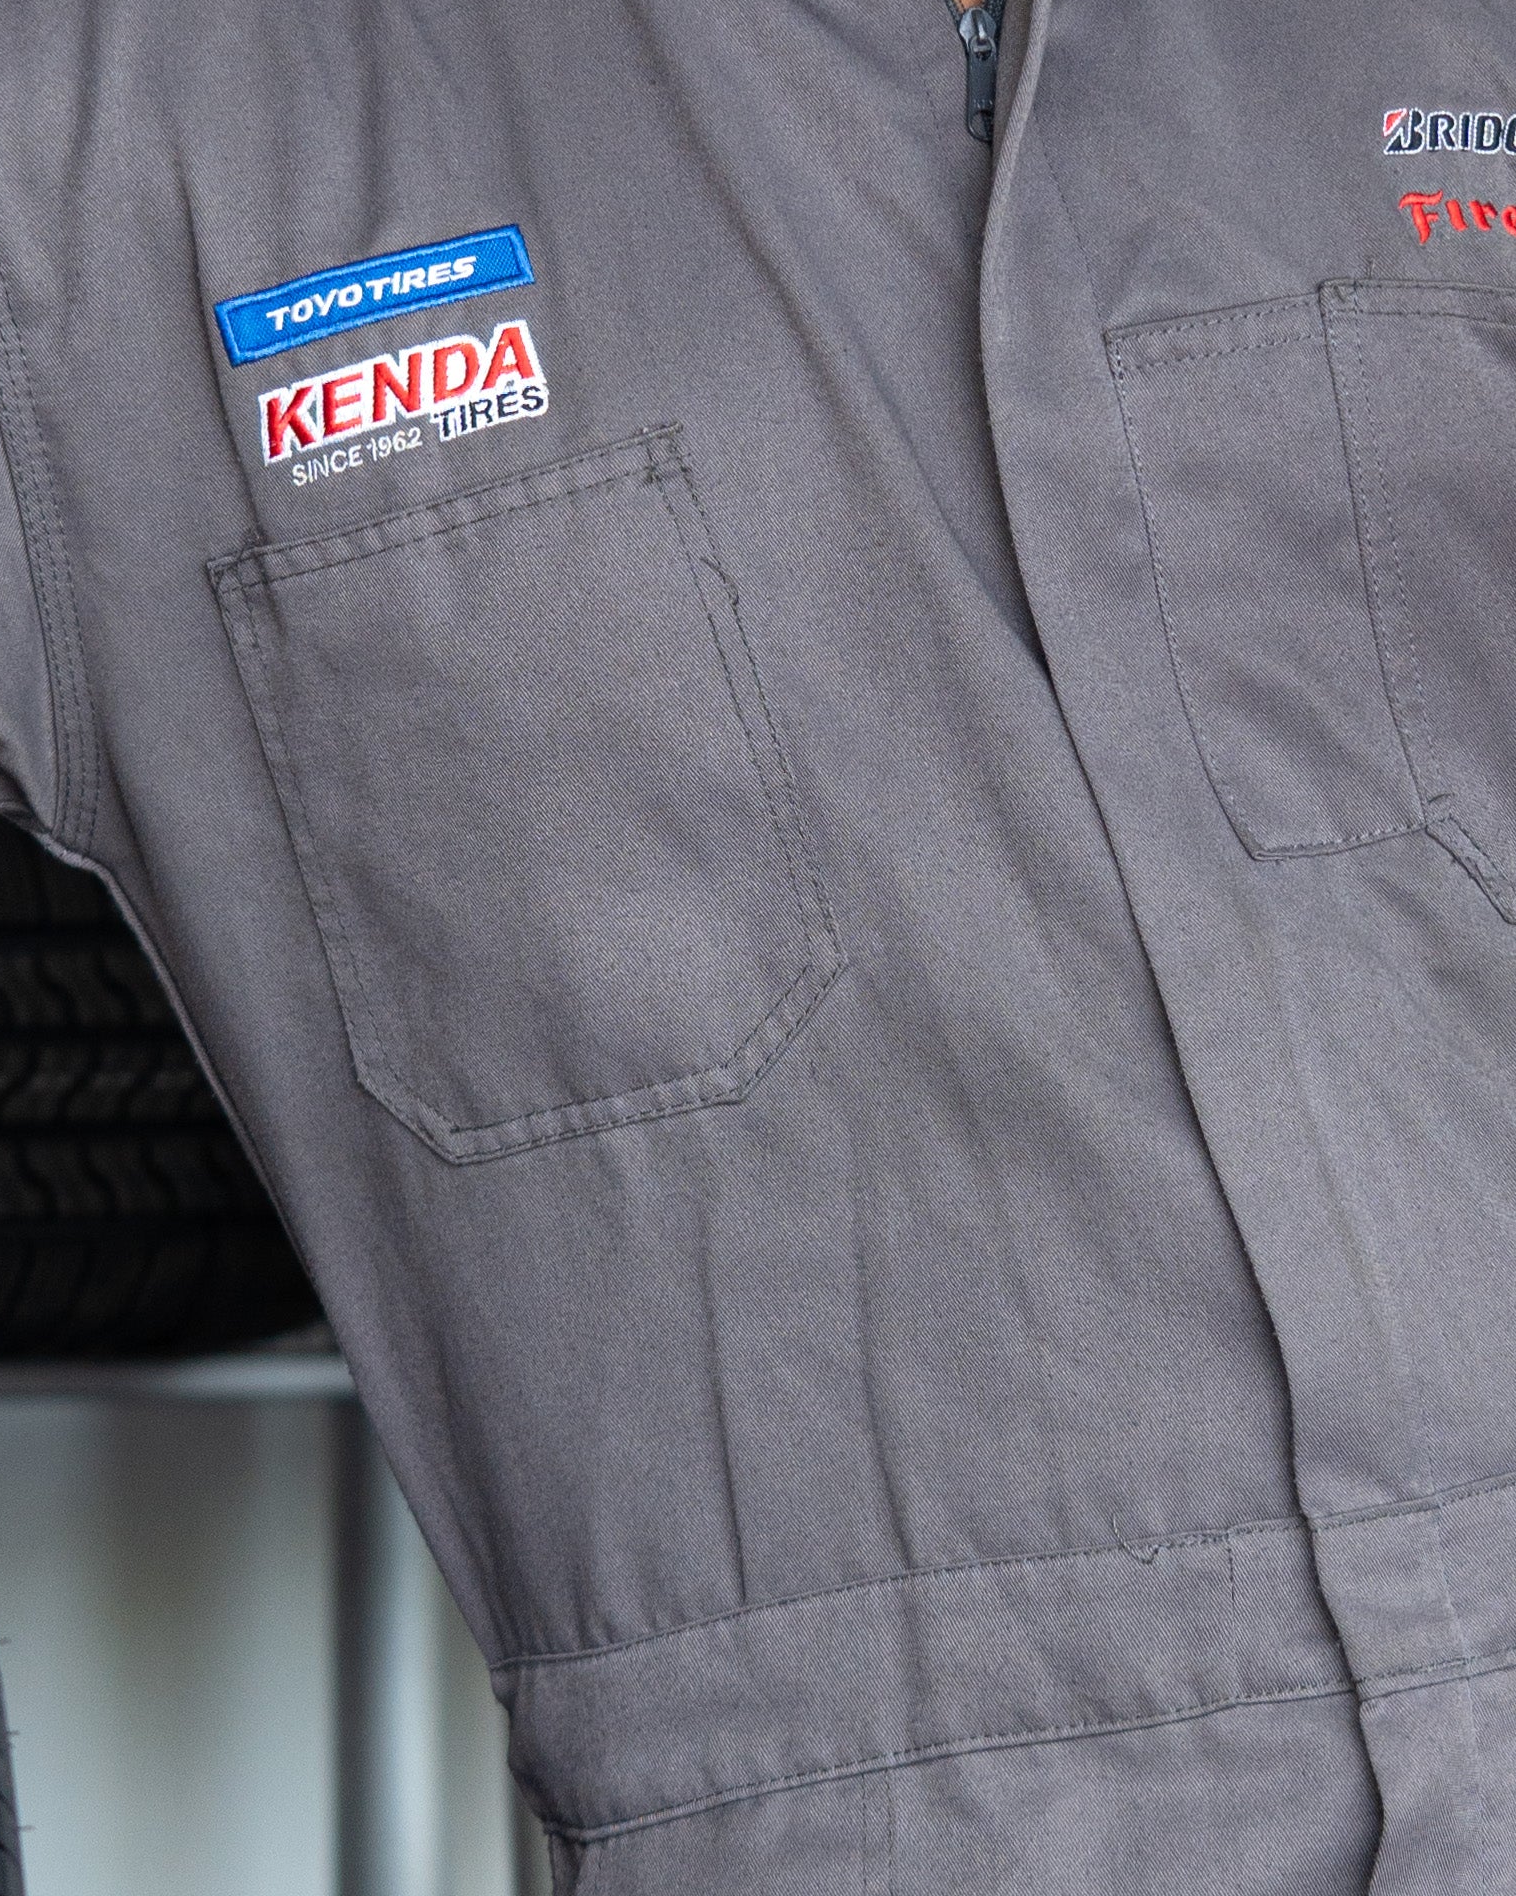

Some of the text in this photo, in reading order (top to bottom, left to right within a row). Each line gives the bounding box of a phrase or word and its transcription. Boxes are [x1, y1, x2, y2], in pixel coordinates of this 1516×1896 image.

[266, 255, 479, 332] TOYO TIRES
[262, 322, 539, 462] KENDA
[434, 383, 547, 438] TIRES
[290, 427, 422, 487] SINCE 1962
